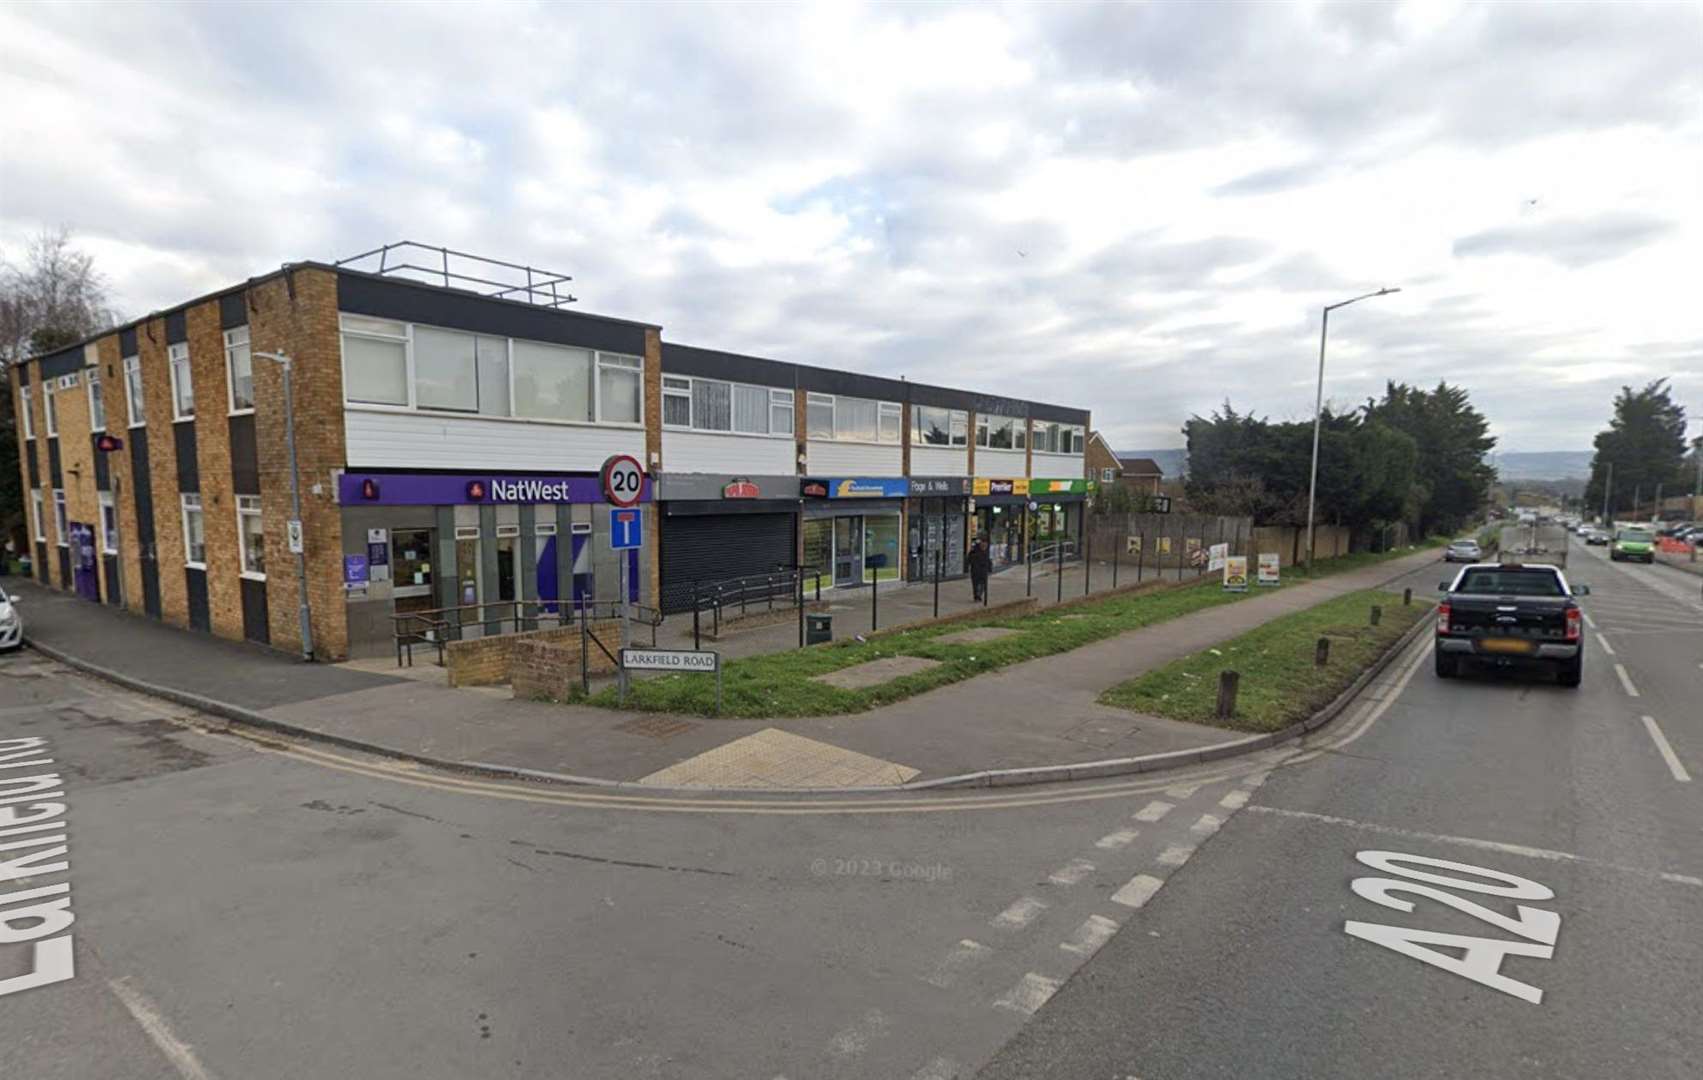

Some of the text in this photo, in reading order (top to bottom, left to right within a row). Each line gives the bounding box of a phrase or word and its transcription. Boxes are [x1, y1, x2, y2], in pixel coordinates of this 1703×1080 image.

[491, 479, 569, 500] NatWest
[613, 471, 639, 492] 20
[625, 654, 714, 666] LARKFIELD ROAD
